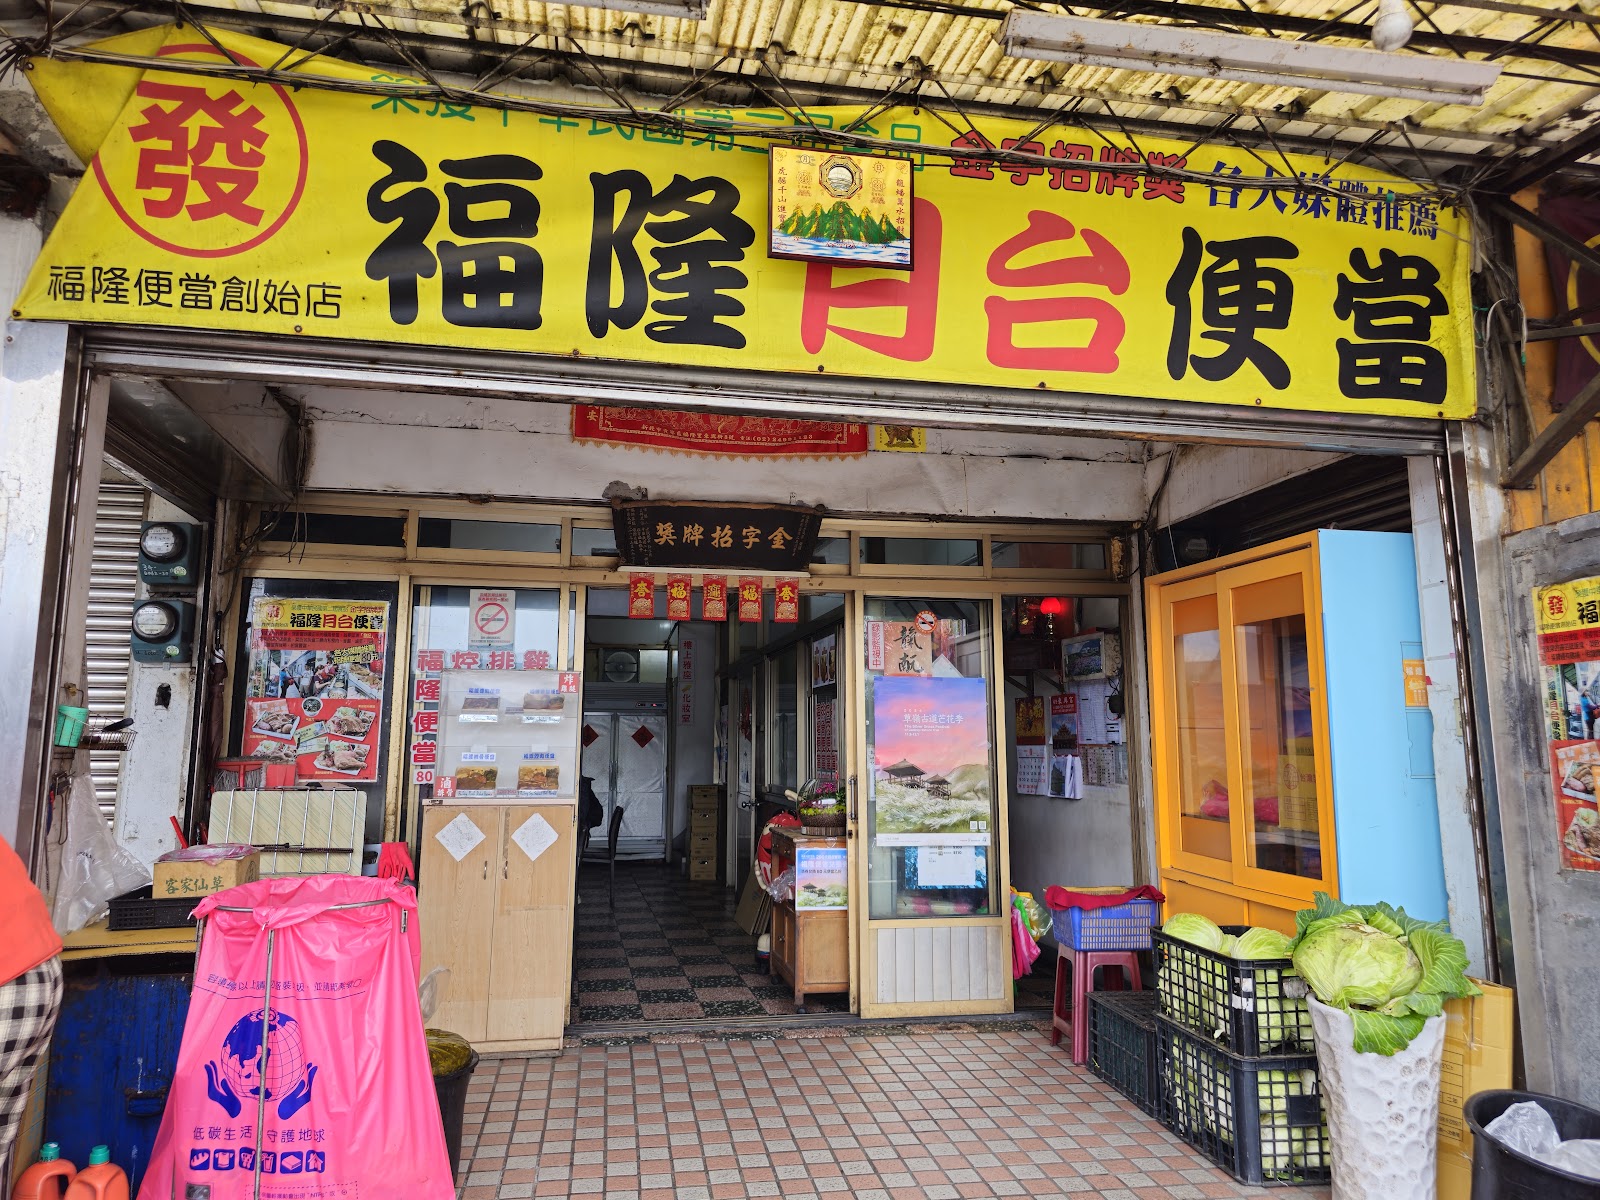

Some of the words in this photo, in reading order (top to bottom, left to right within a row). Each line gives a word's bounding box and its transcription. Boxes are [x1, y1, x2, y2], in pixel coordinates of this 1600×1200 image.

[129, 83, 269, 227] 發
[950, 130, 1186, 204] 金字招牌獎
[1209, 161, 1438, 240] 各大媒體推薦
[366, 139, 1448, 406] 福隆月台便當
[47, 265, 342, 319] 福隆便當創始店
[670, 582, 687, 599] 福
[743, 584, 759, 601] 福
[1547, 595, 1564, 616] 發
[416, 771, 433, 783] 80
[165, 875, 225, 895] 客家仙草
[193, 1125, 253, 1142] 低碳生活
[267, 1127, 326, 1145] 守護地球
